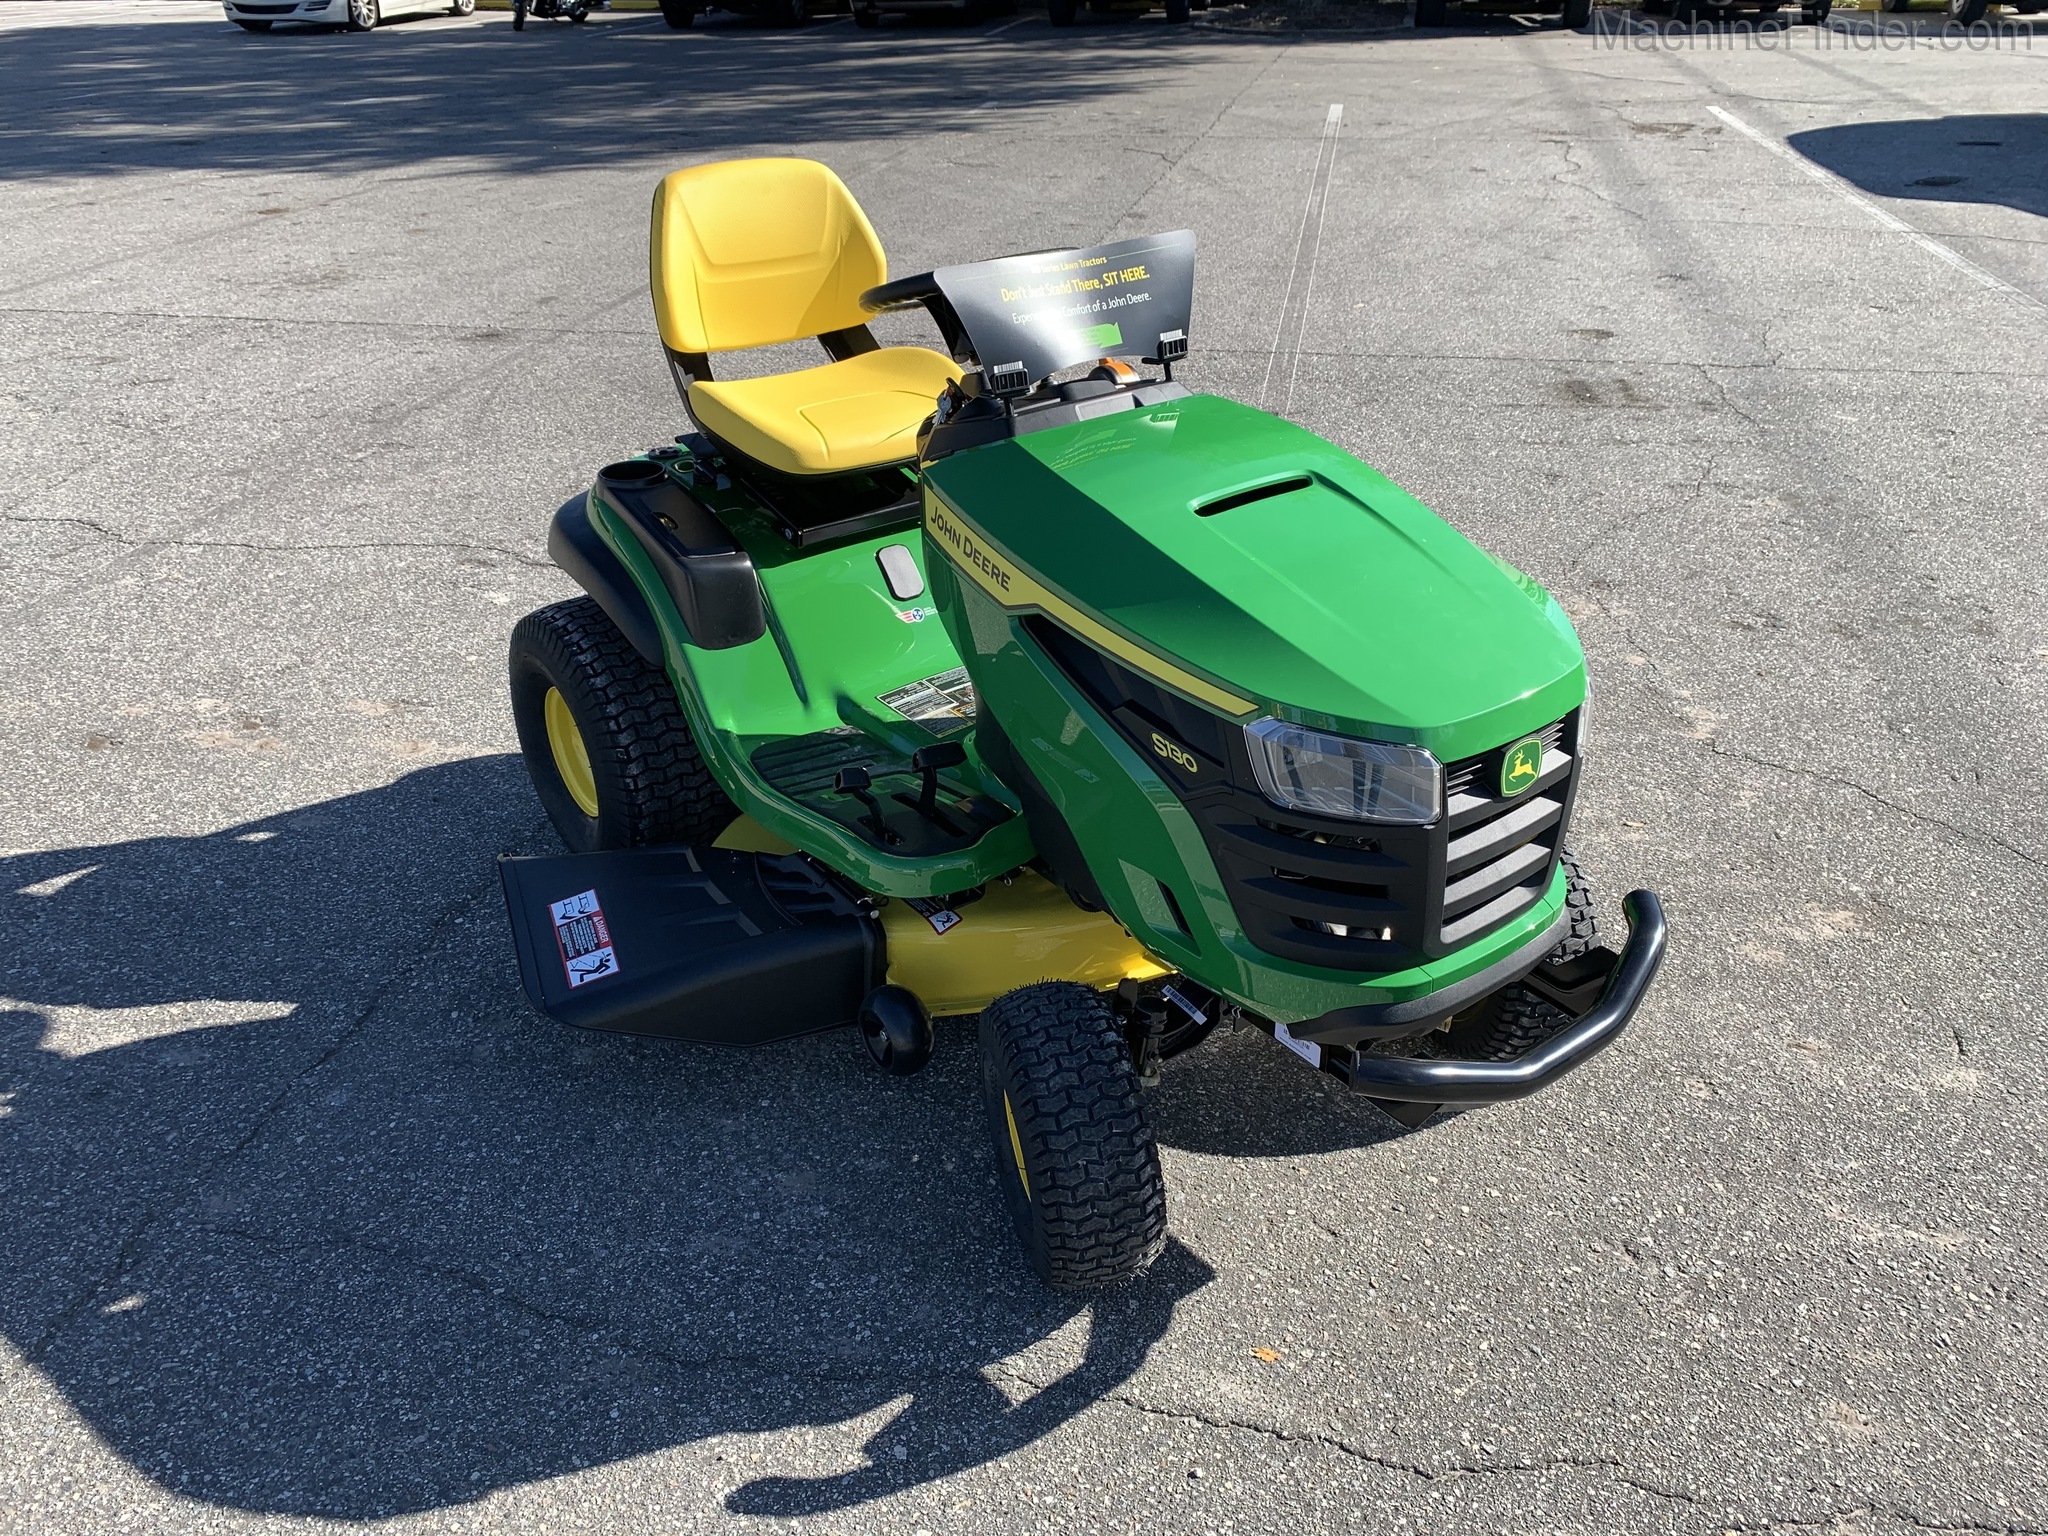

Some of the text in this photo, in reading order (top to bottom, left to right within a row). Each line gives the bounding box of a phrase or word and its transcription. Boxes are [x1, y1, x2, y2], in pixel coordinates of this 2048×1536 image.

[1060, 262, 1079, 271] Lawn
[1078, 256, 1107, 268] Tractors
[1000, 285, 1028, 302] Don't
[1045, 279, 1072, 297] Stand
[1071, 277, 1104, 293] There,
[1102, 270, 1119, 287] SIT
[1119, 265, 1151, 283] HERE.
[1062, 303, 1092, 317] Comfort
[1092, 299, 1101, 312] of
[1101, 301, 1108, 310] a
[1107, 295, 1127, 309] John
[1126, 292, 1152, 305] Deere.
[930, 505, 1012, 593] JOHN DEERE
[1151, 732, 1198, 773] S130
[595, 920, 609, 943] DANGER
